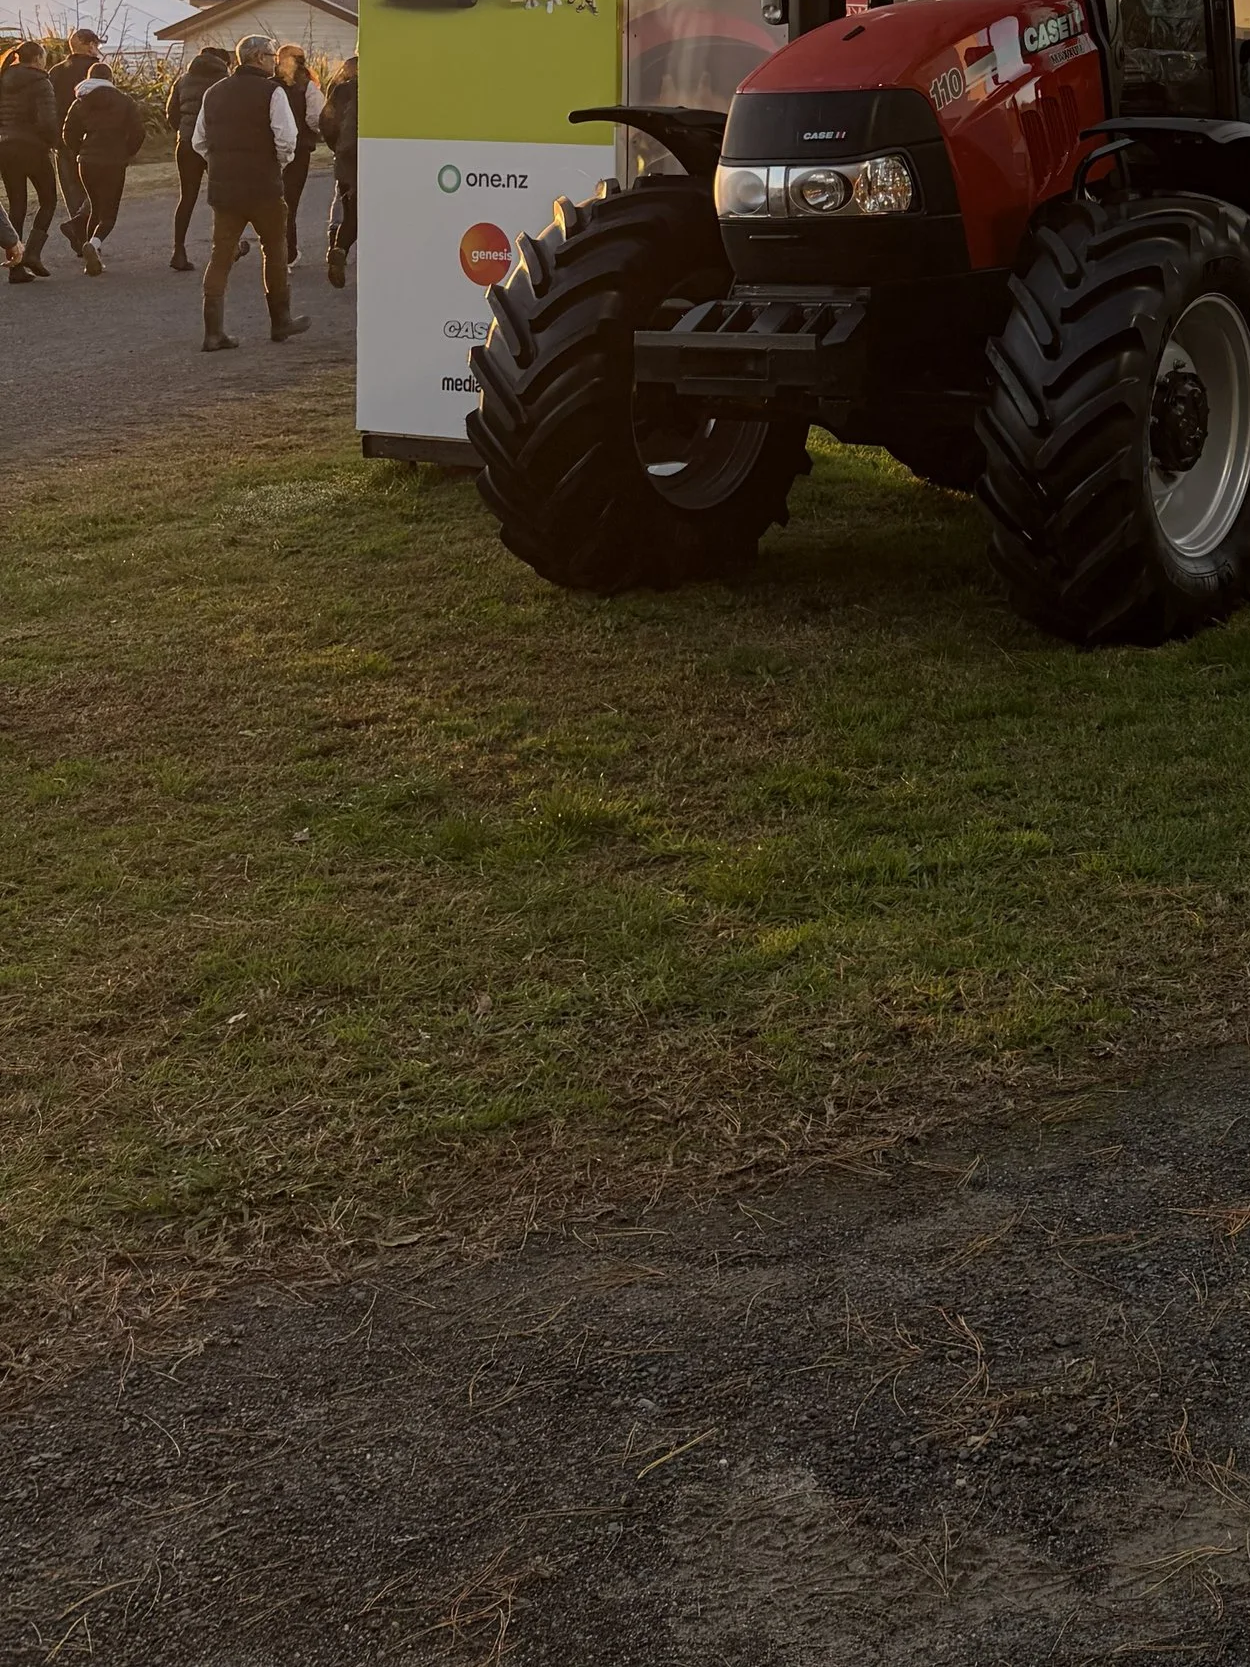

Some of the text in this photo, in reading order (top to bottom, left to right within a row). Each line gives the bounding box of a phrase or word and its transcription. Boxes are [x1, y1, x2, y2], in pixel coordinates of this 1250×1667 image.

[1023, 16, 1070, 53] CASE
[929, 67, 965, 110] 110
[803, 131, 834, 141] CASE
[465, 171, 528, 189] one.nz
[471, 249, 513, 263] genesis
[443, 320, 490, 340] CAS
[442, 375, 482, 393] media
